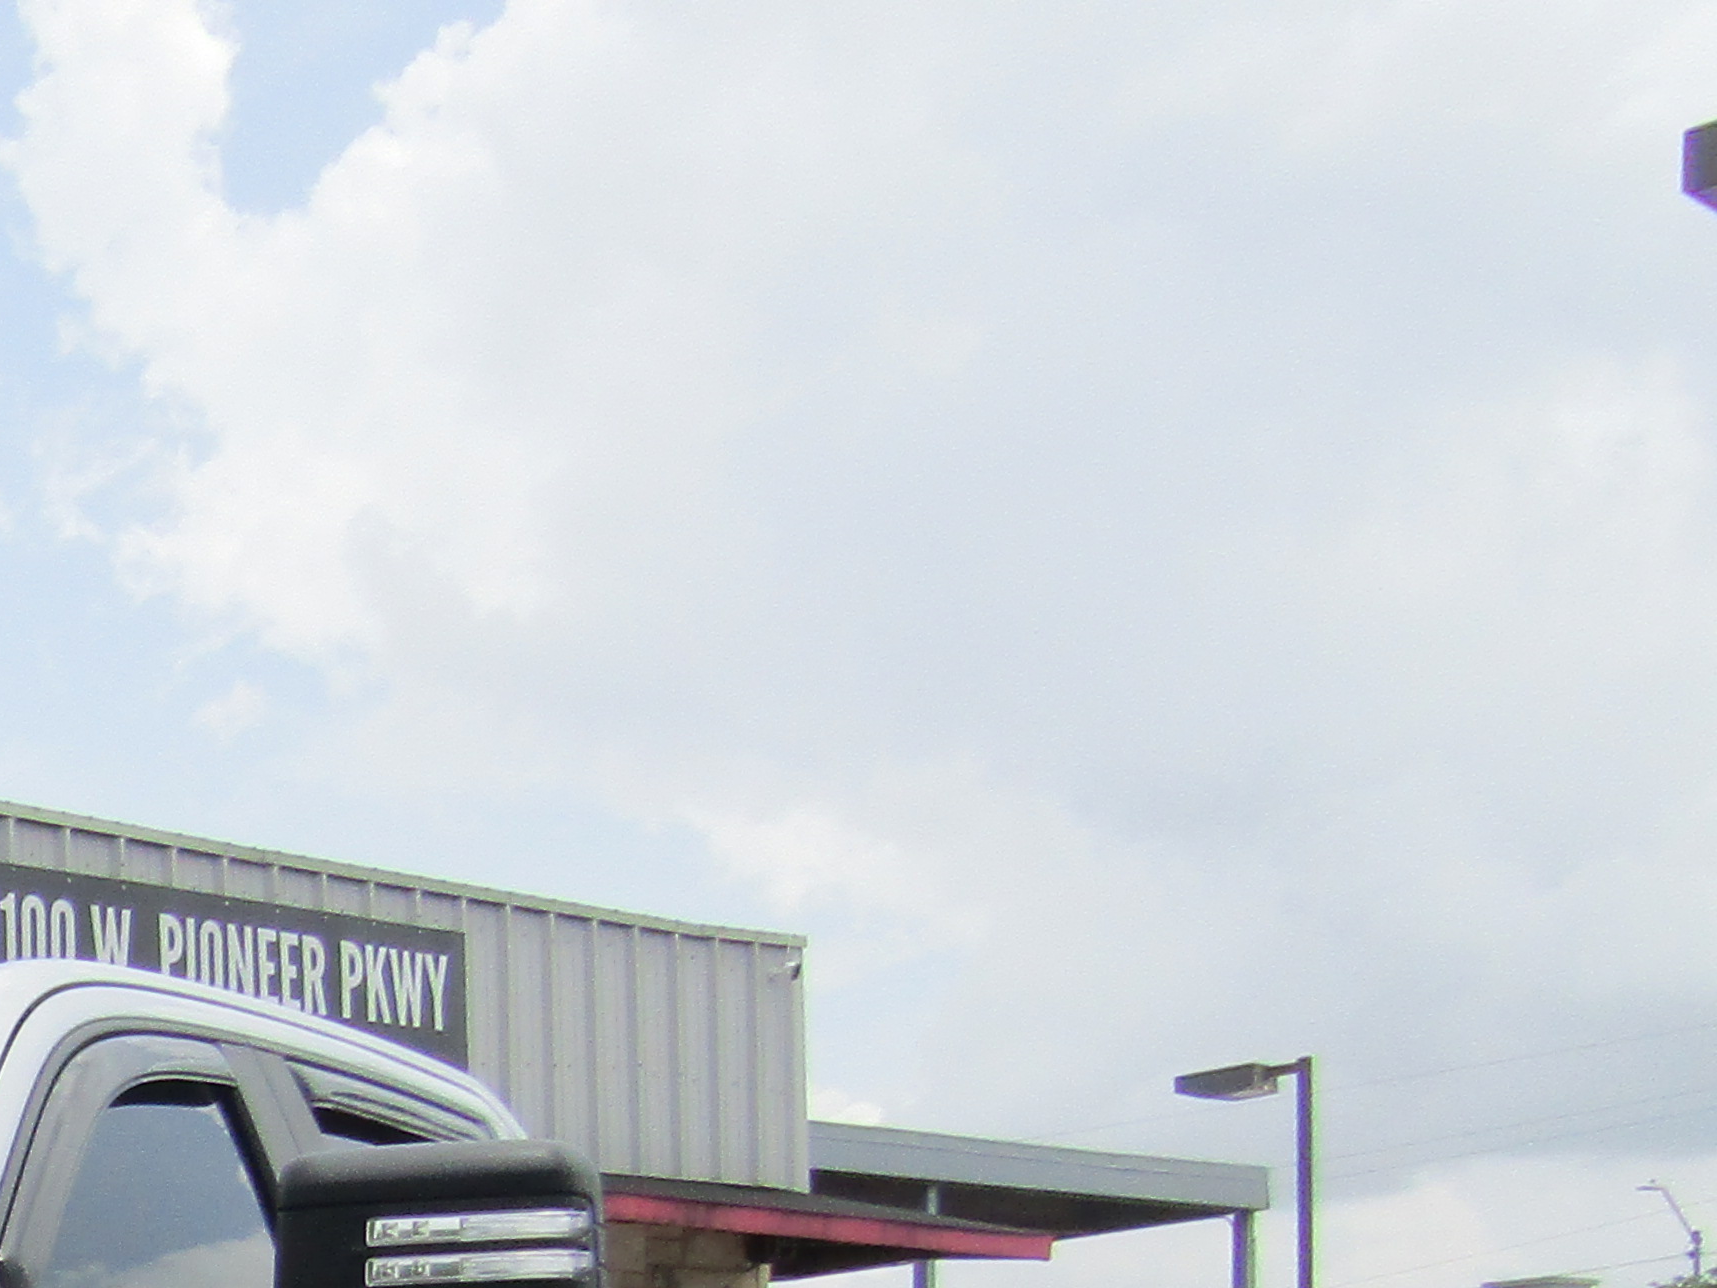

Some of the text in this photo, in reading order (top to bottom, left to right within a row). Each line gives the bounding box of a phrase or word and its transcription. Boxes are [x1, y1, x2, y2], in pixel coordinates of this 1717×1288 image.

[89, 904, 132, 967] W
[158, 912, 328, 1016] PIONEER
[339, 940, 449, 1032] PKWY
